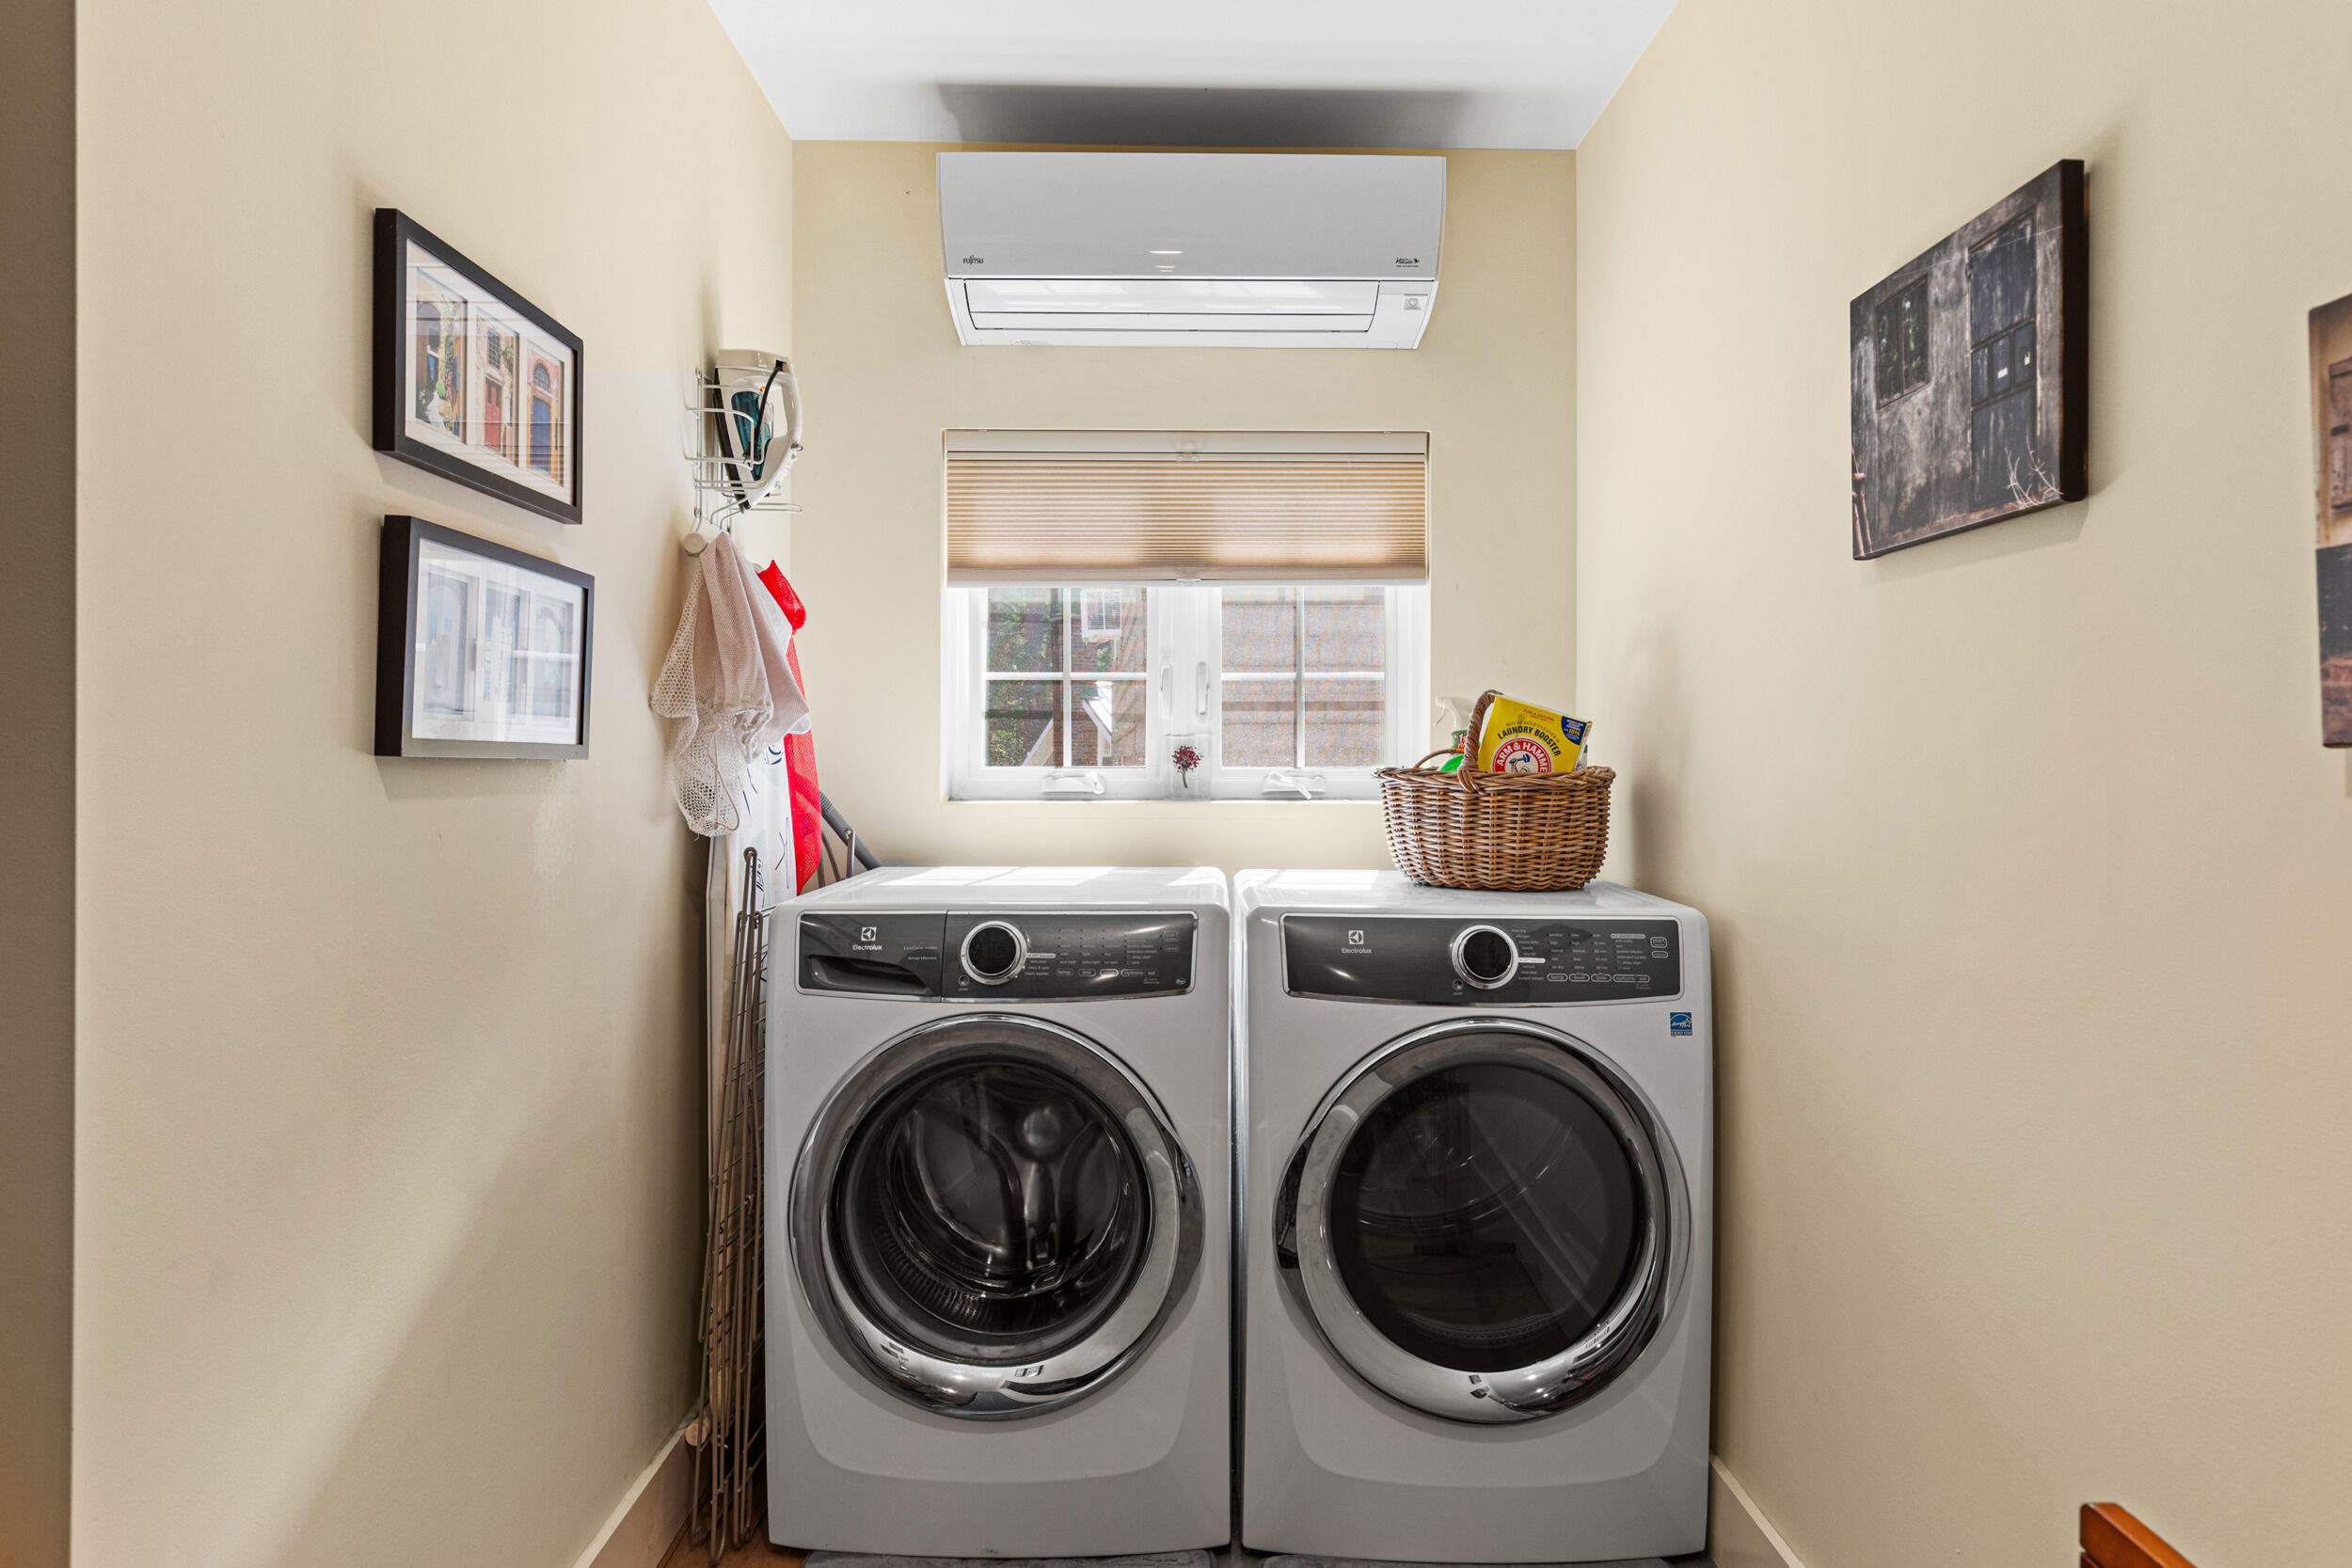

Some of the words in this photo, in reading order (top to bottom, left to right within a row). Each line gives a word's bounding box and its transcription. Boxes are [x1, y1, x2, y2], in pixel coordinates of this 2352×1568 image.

[962, 255, 983, 265] FUJITSU
[1498, 726, 1534, 739] LAUNDRY
[1534, 729, 1562, 756] BOOSTER
[1497, 745, 1513, 767] ARM
[1513, 741, 1521, 751] &
[1522, 742, 1549, 773] HAMME
